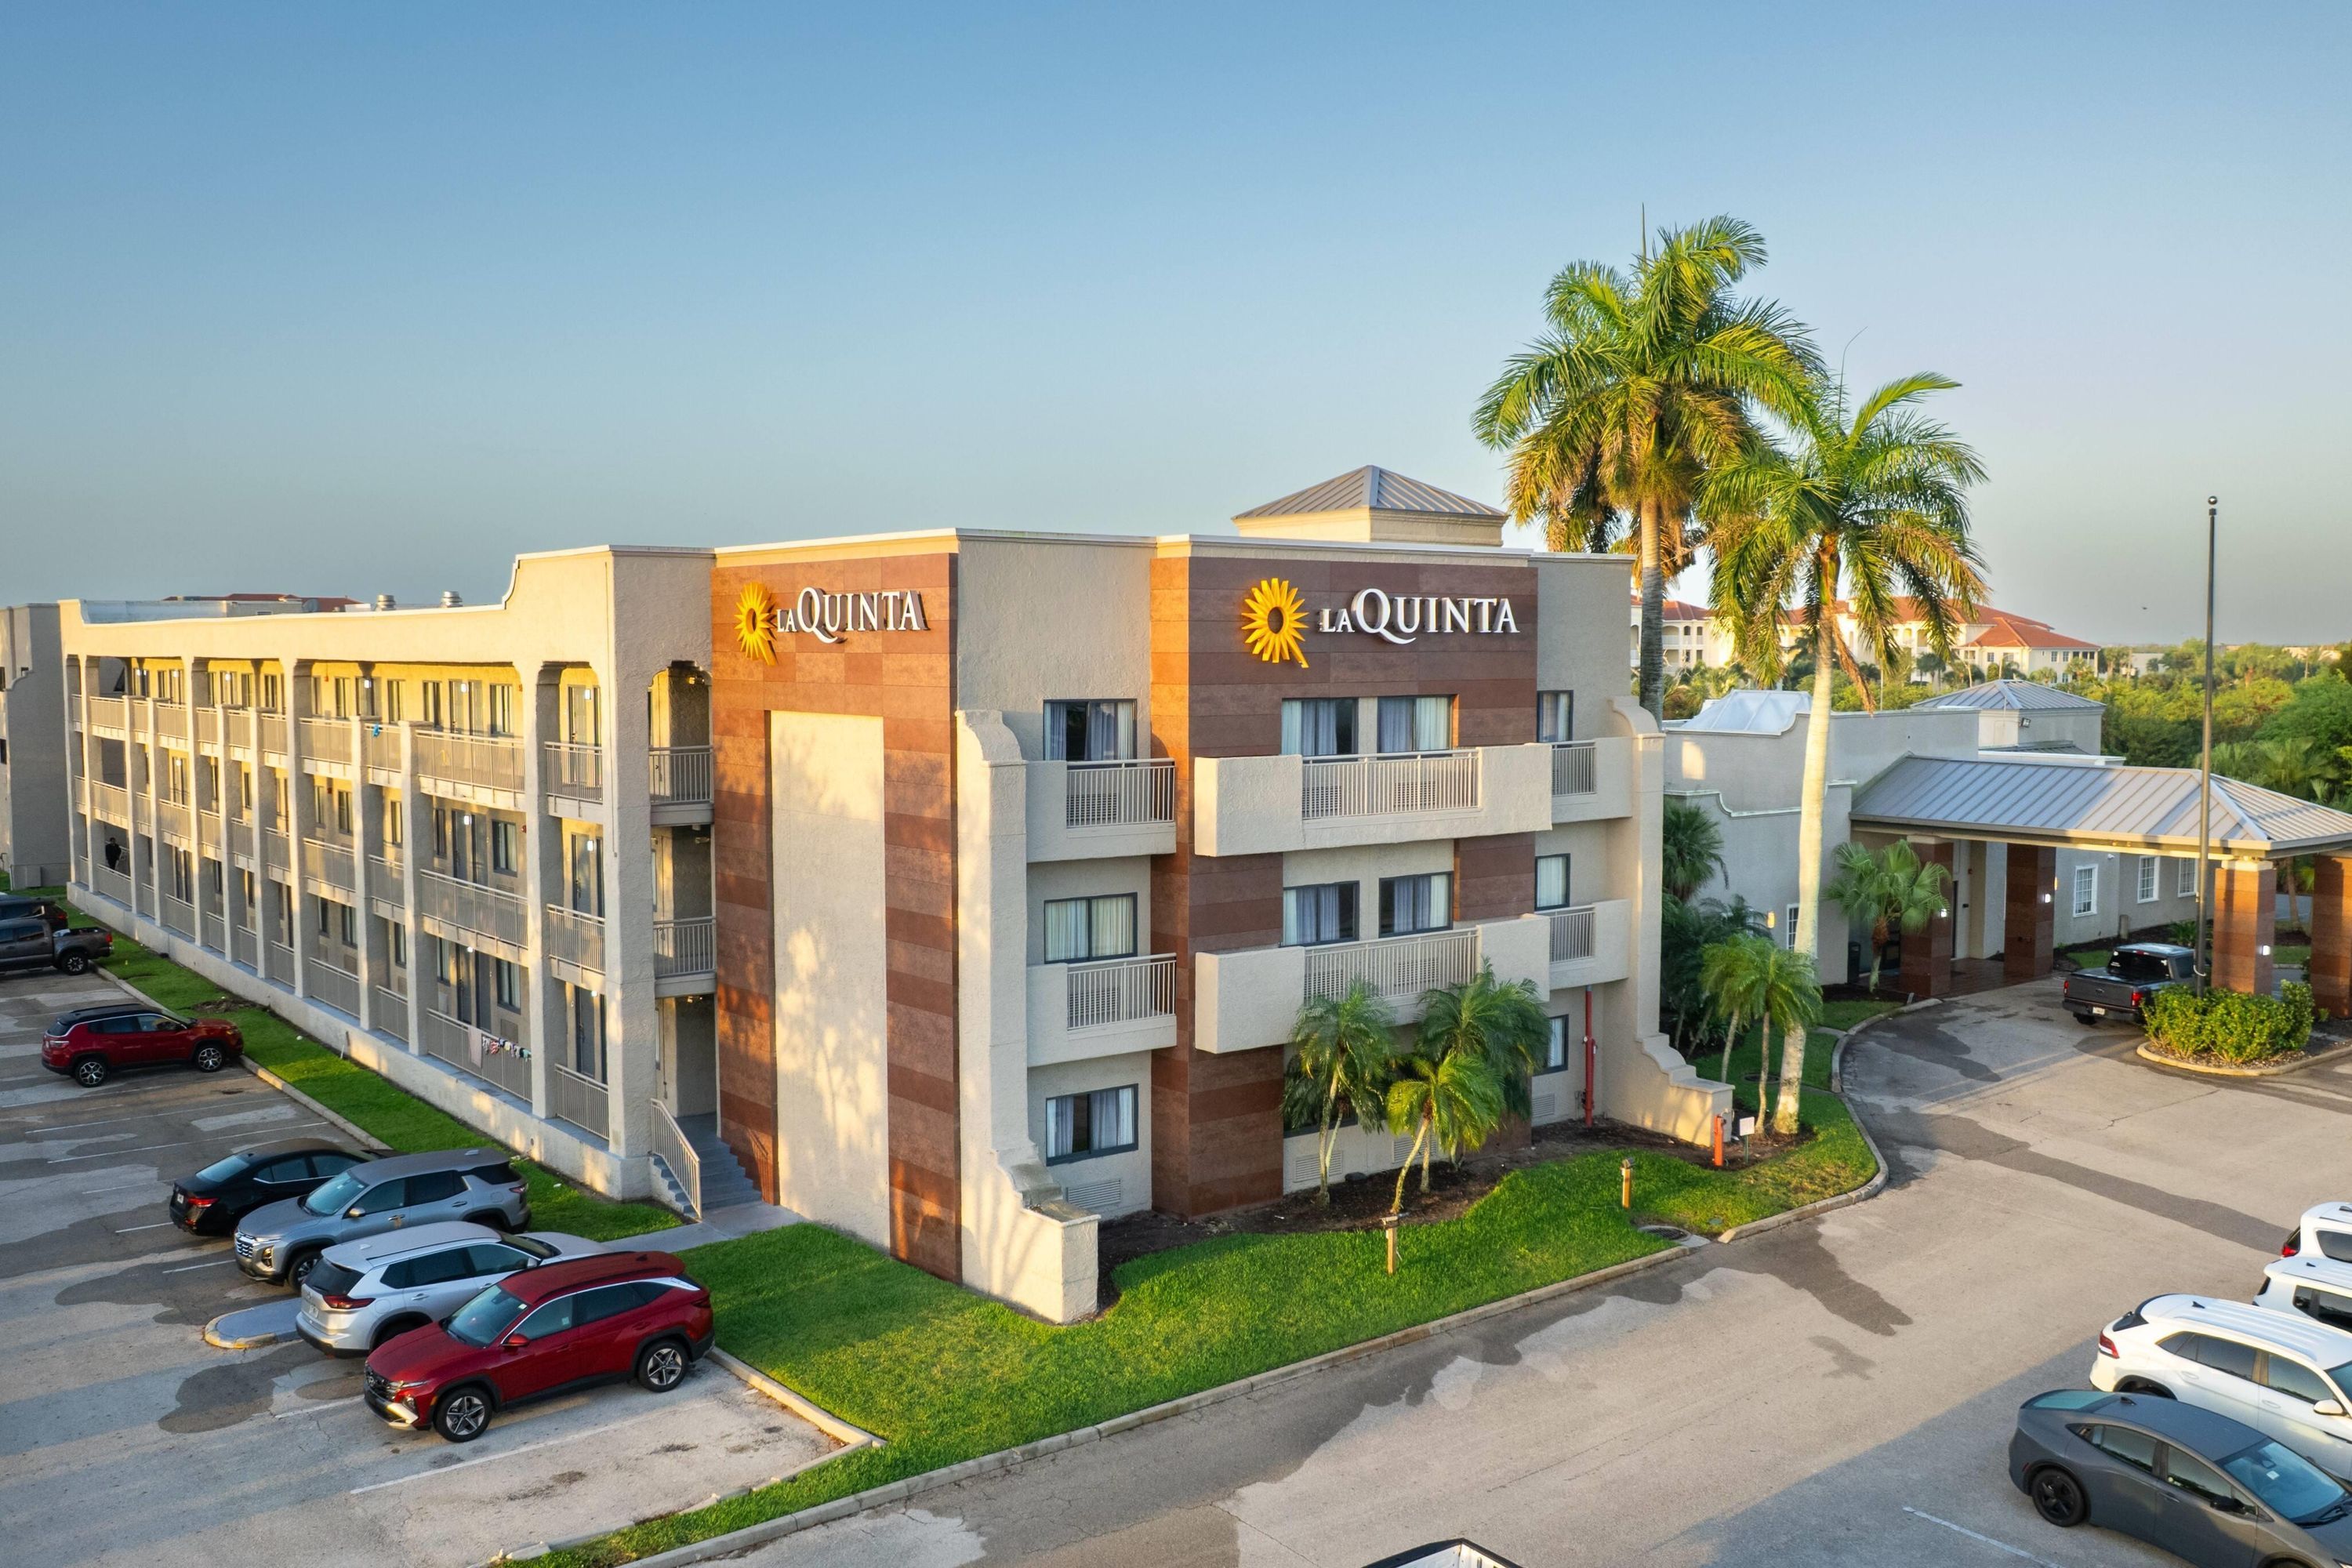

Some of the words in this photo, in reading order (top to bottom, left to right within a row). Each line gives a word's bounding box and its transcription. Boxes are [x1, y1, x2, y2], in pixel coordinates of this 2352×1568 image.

[777, 608, 797, 633] LA
[797, 586, 922, 644] QUINTA
[1319, 608, 1355, 633] LA
[1351, 588, 1520, 644] QUINTA
